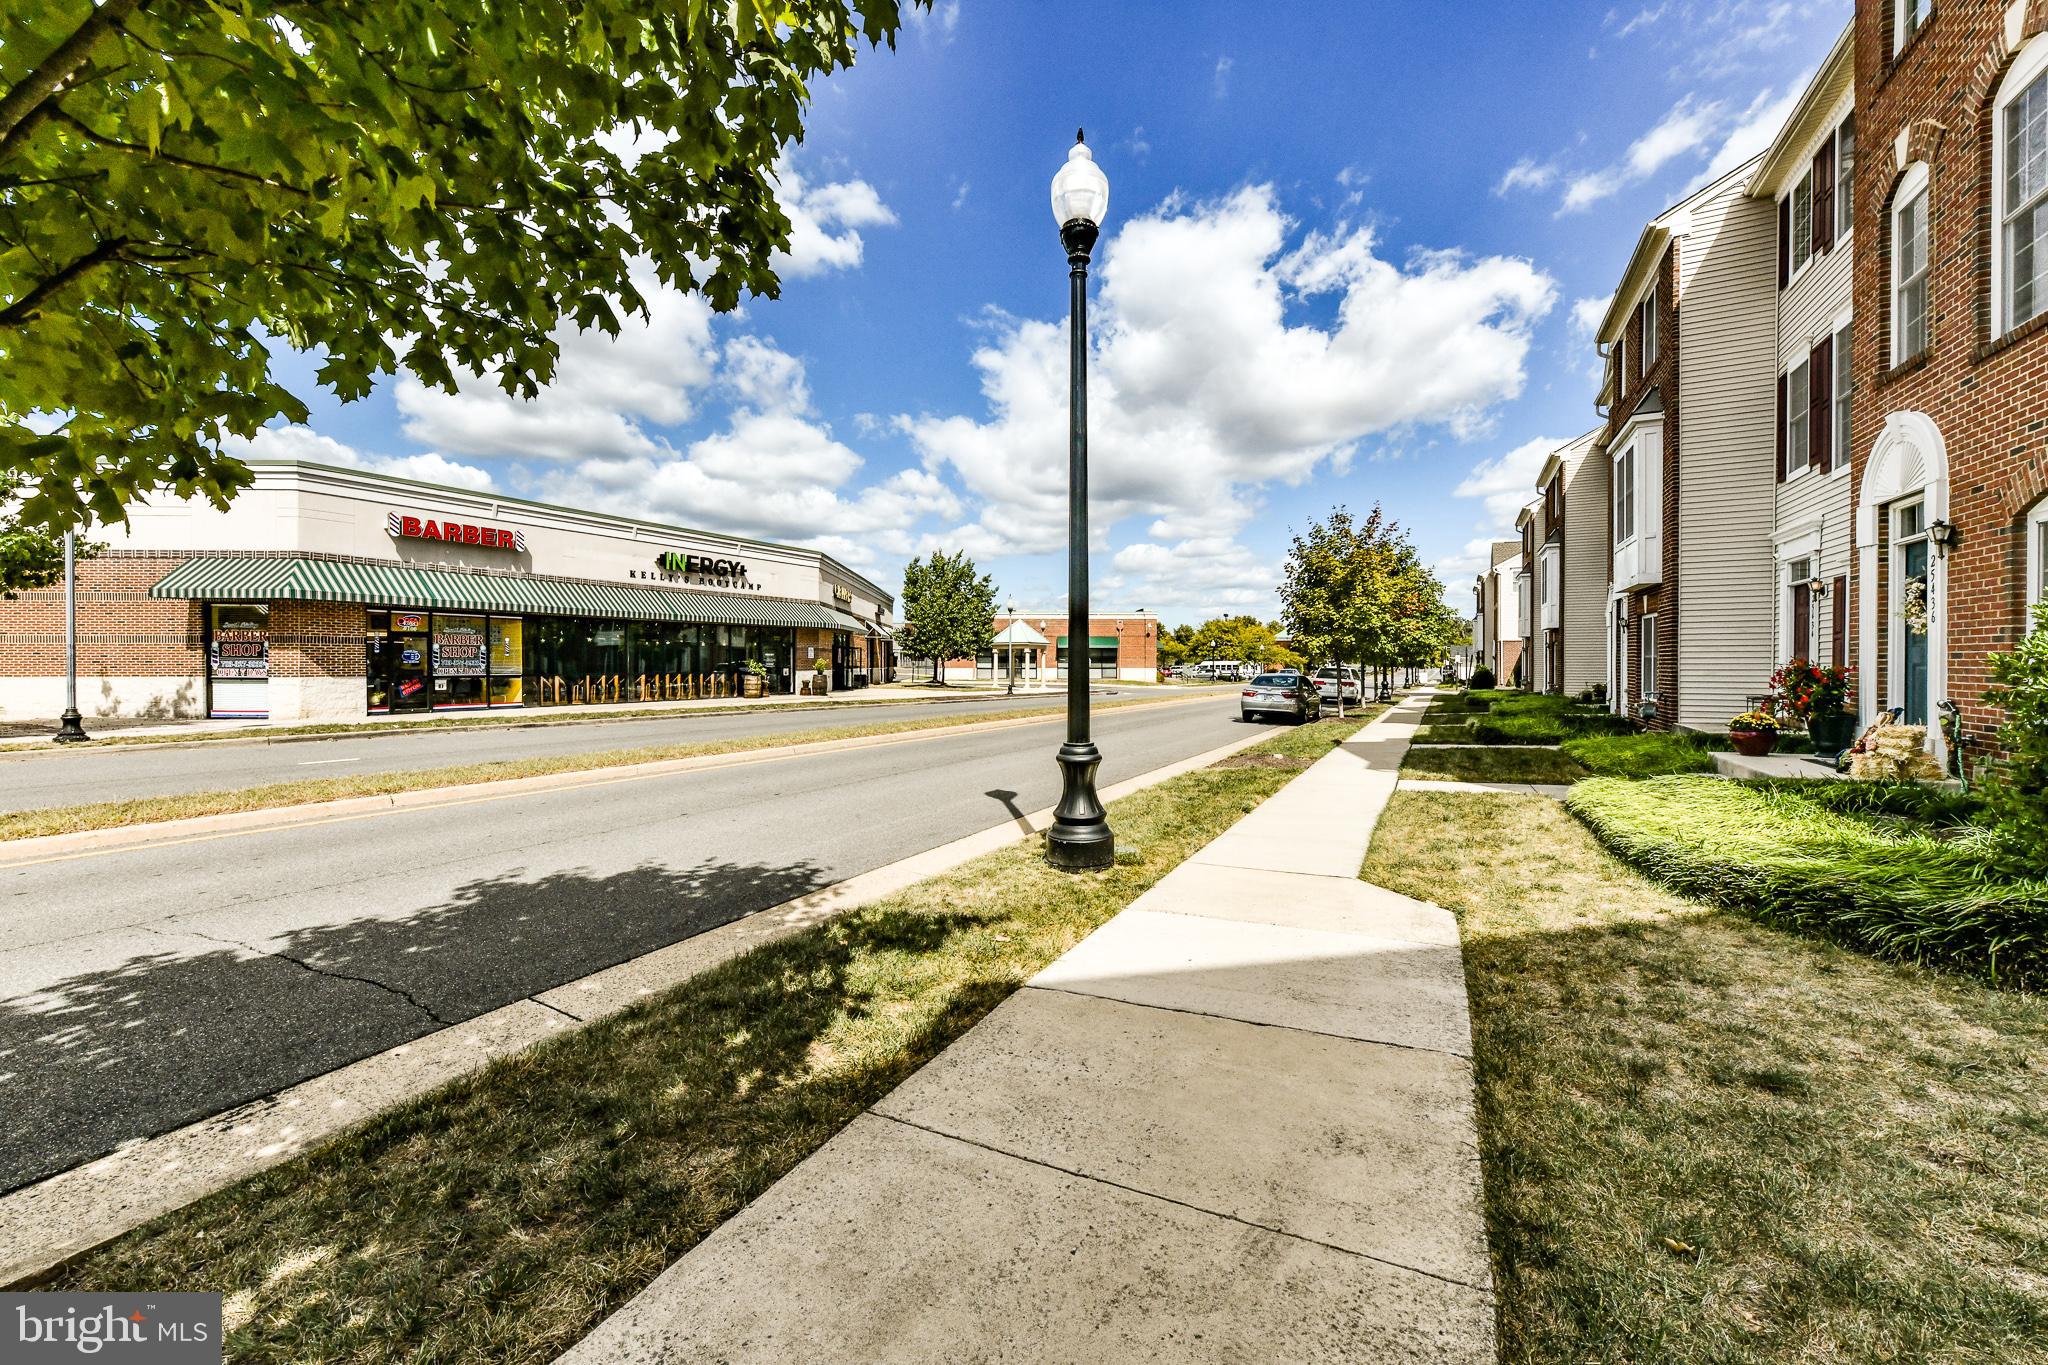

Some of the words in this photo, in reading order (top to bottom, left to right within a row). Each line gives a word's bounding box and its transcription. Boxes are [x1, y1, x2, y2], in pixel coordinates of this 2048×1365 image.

[402, 516, 515, 549] BARBER
[629, 570, 689, 584] KELLY'S
[698, 577, 761, 591] BOOTCAMP
[213, 629, 267, 642] BARBER
[434, 633, 483, 645] BARBER
[222, 644, 261, 656] SHOP
[442, 646, 477, 658] SHOP
